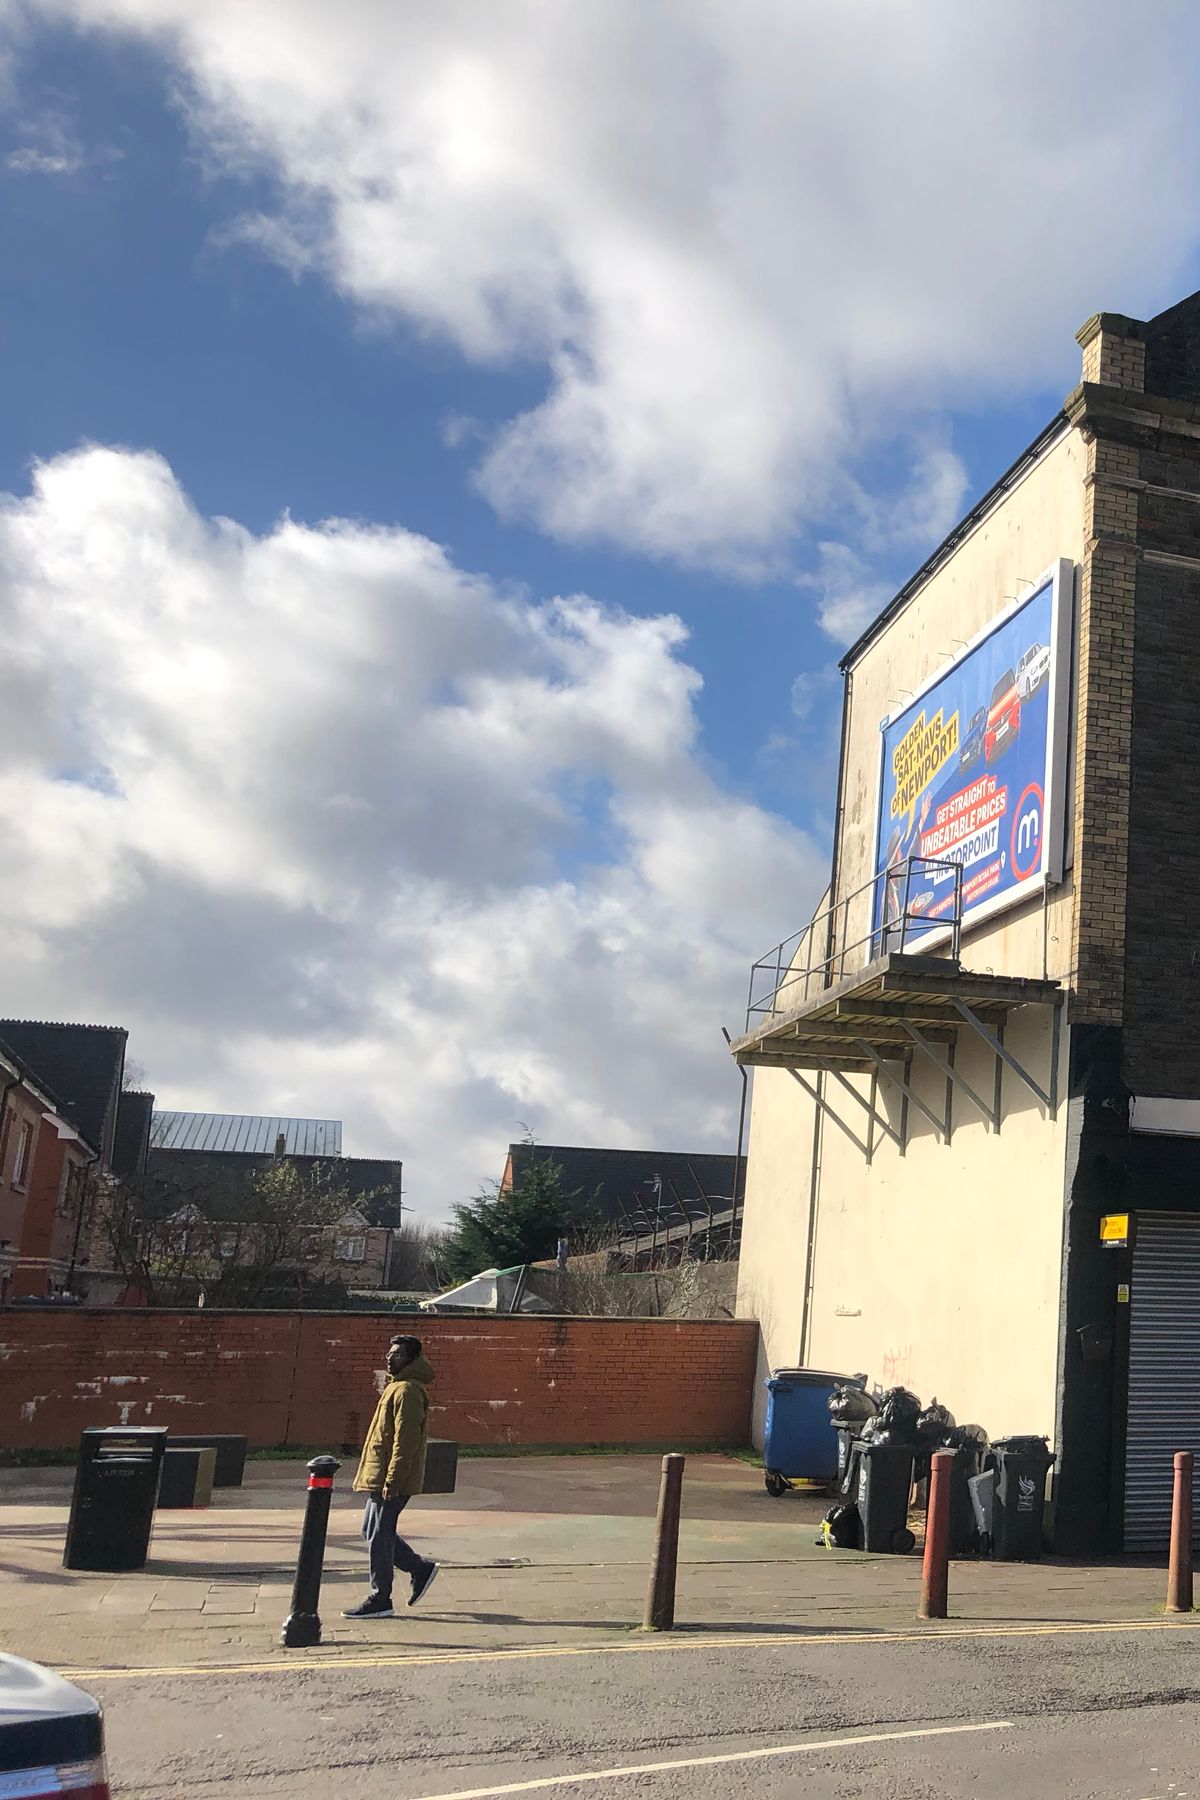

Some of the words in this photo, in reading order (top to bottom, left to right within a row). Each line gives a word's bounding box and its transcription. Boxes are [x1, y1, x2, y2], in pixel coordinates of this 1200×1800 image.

[891, 792, 901, 814] OF
[901, 719, 958, 812] NEWPORT!
[894, 715, 925, 770] GOLDEN
[897, 716, 942, 786] SAT-NAVS
[921, 810, 976, 857] UNBEATABLE
[976, 791, 1006, 823] PRICES
[936, 804, 950, 826] GET
[949, 778, 987, 819] STRAIGHT
[987, 780, 996, 795] TO
[935, 826, 997, 879] MOTORPOINT
